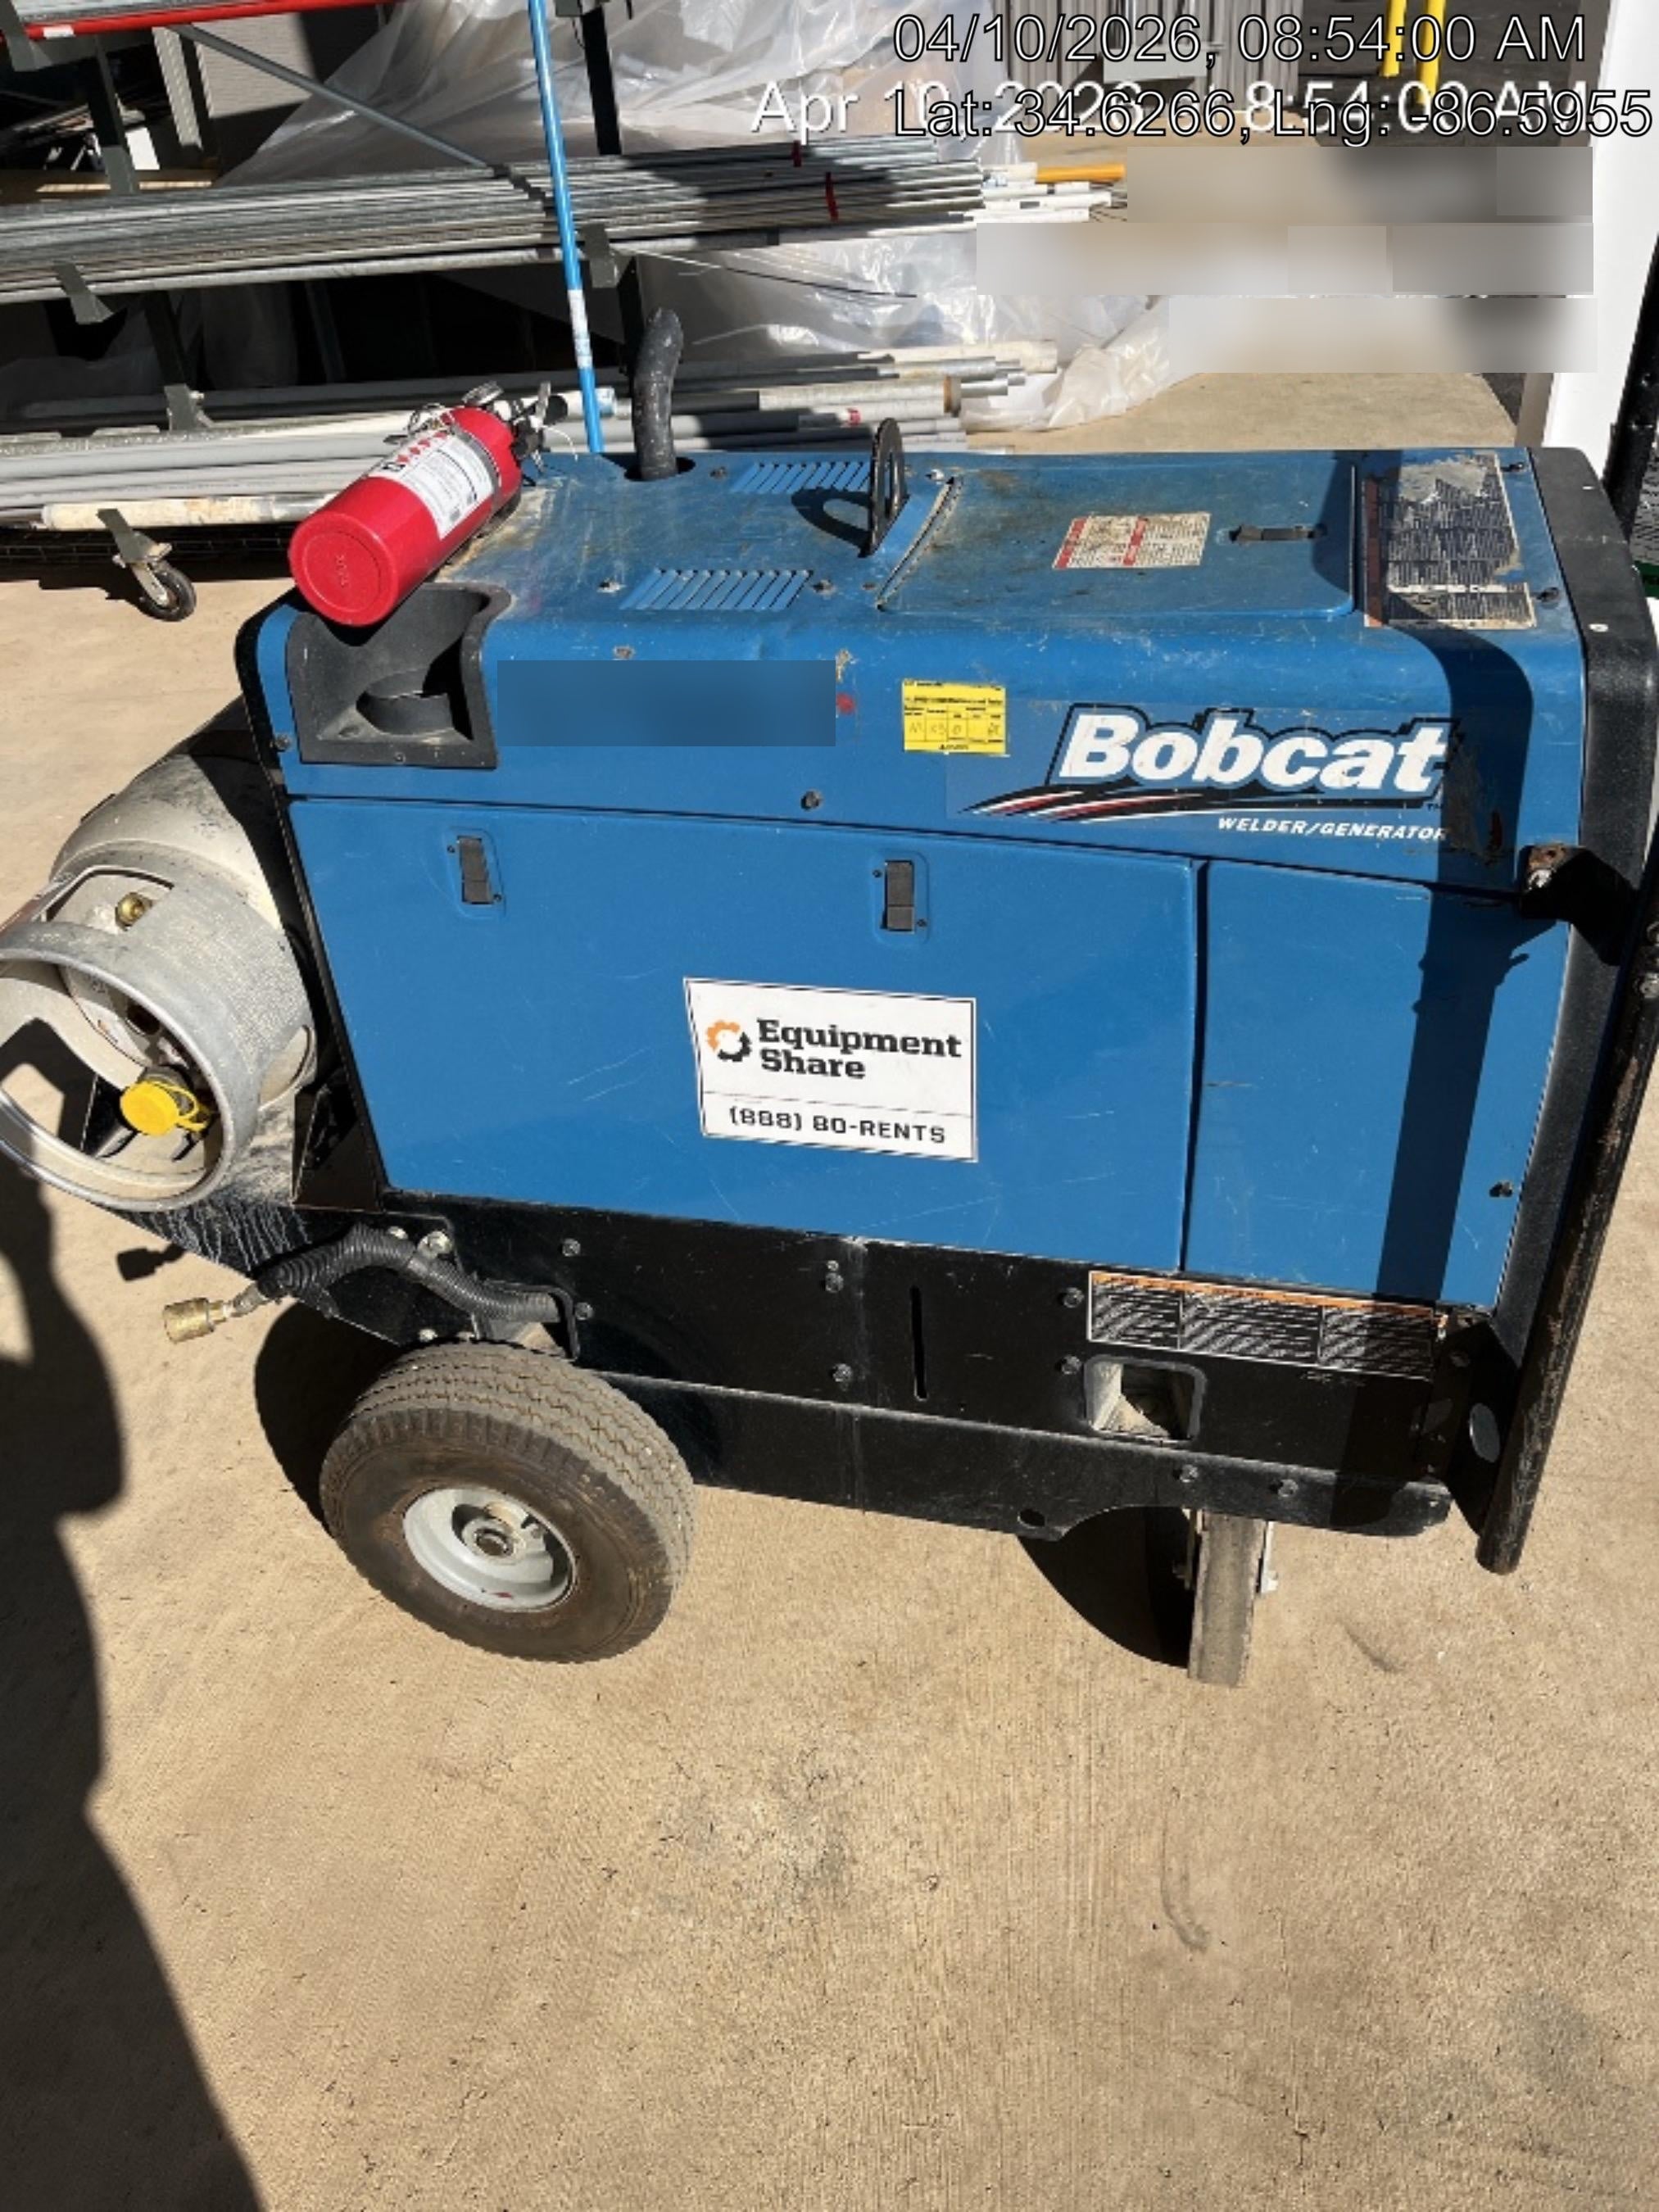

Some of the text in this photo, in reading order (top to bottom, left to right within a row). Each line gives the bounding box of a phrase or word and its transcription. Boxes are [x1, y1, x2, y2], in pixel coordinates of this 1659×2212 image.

[1058, 713, 1448, 793] Bobcat
[756, 1017, 962, 1058] Equipment
[760, 1049, 866, 1080] Share
[729, 1106, 946, 1144] (888) 80-RENTS
